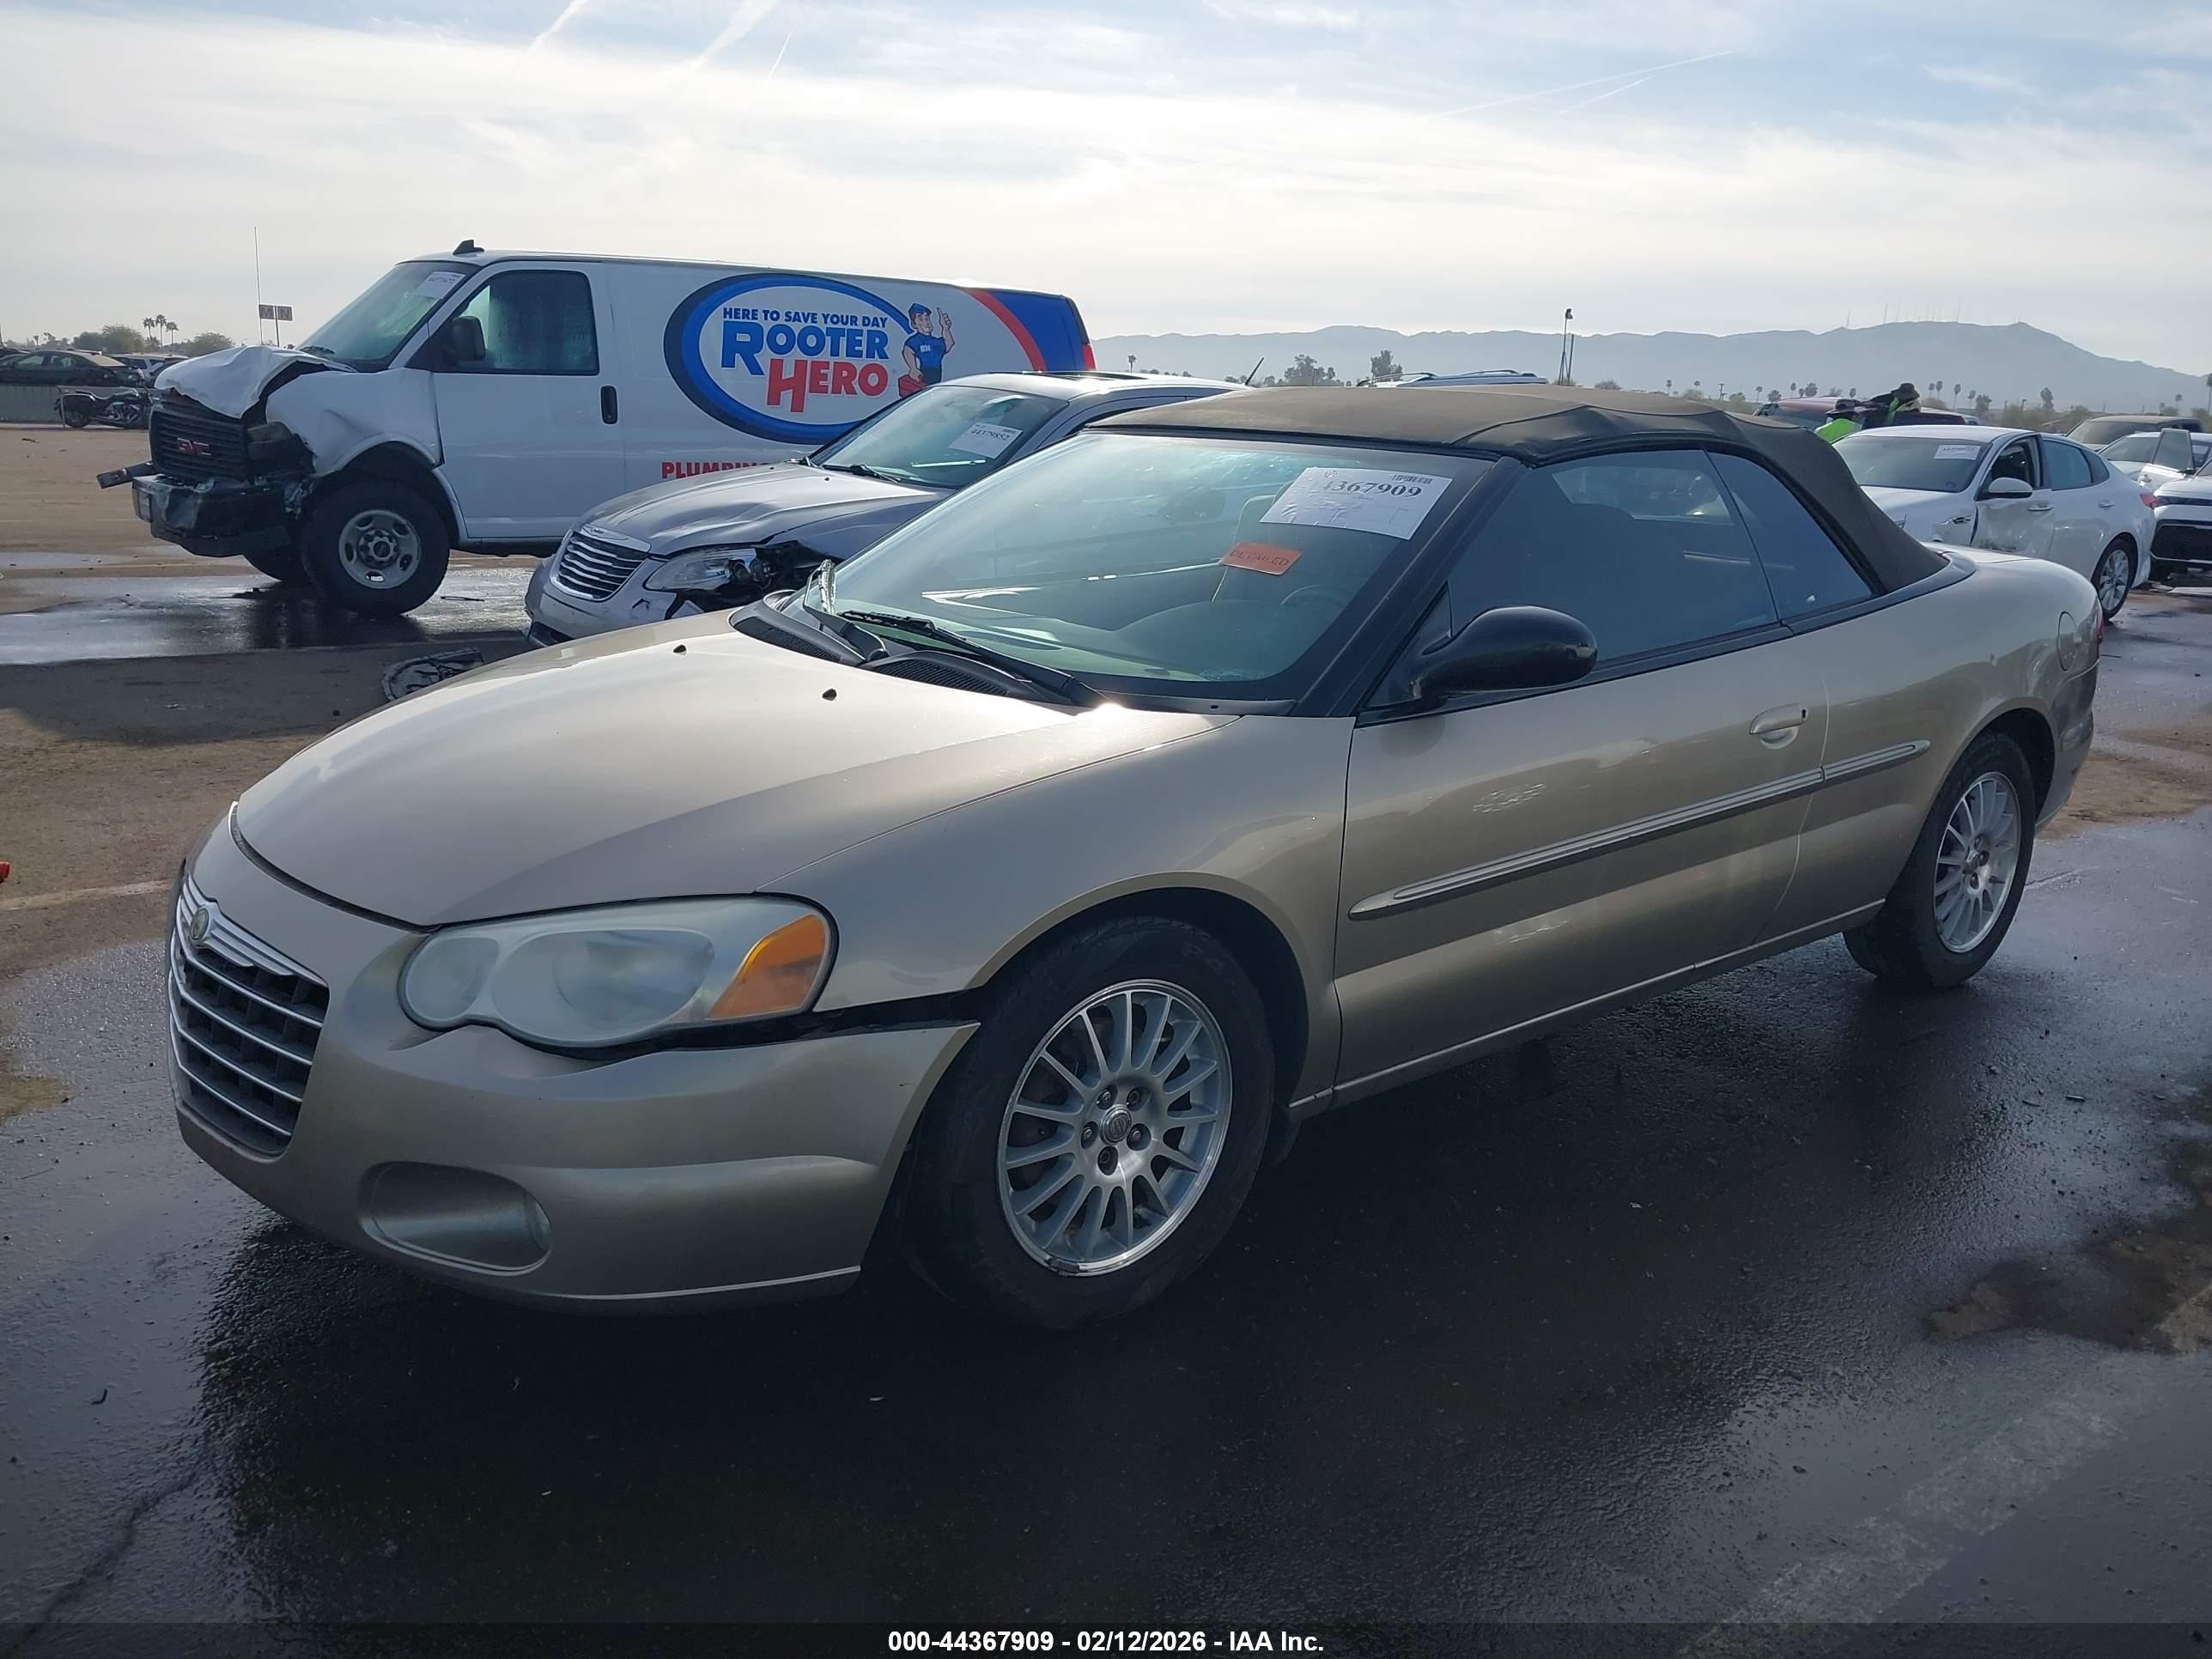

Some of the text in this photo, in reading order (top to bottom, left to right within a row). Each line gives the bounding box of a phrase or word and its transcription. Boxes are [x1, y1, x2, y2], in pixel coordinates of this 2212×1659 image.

[723, 307, 888, 329] HERE TO SAVE YOUR DAY
[721, 320, 890, 375] ROOTER
[767, 358, 889, 412] HERO
[177, 437, 212, 456] GMC
